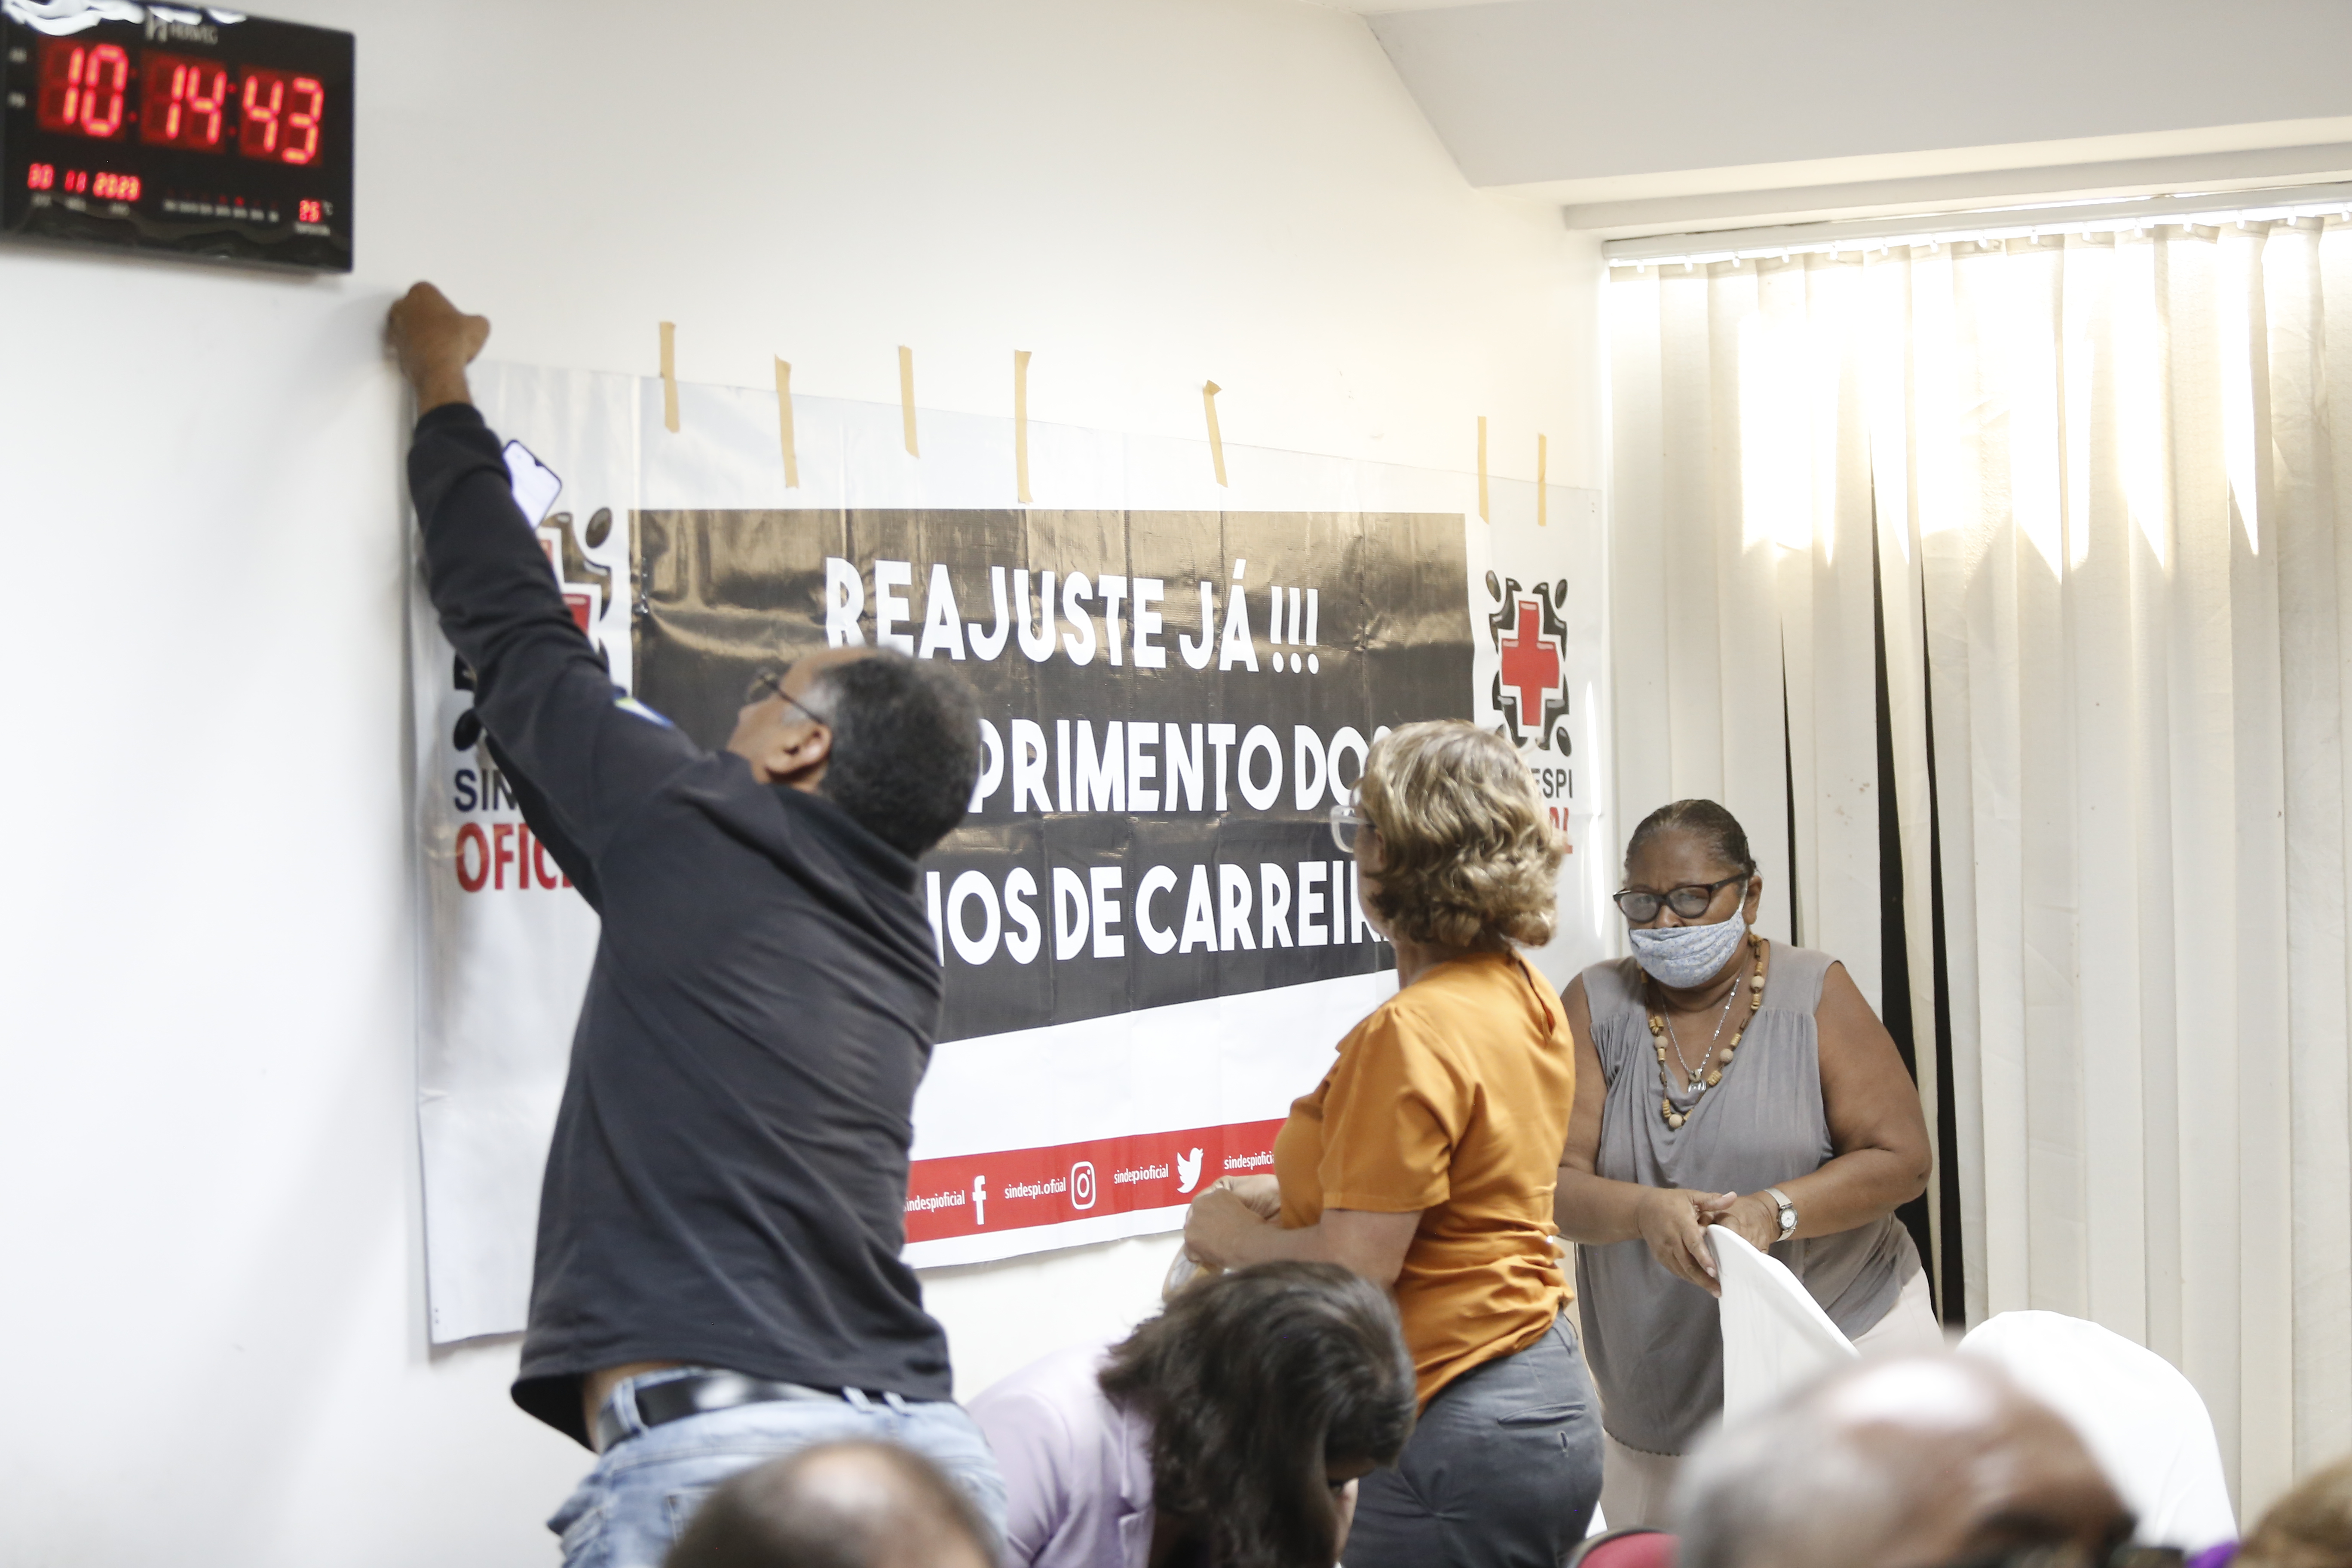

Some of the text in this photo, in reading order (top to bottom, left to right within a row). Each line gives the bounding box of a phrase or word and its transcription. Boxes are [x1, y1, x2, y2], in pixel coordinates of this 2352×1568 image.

[65, 170, 88, 193] 11
[826, 557, 1166, 668] REAJUSTE
[1179, 559, 1260, 672] JÁ
[1294, 725, 1392, 811] DO
[456, 822, 573, 893] OFIC
[1053, 866, 1125, 960] DE
[1135, 861, 1390, 955] CARREIR
